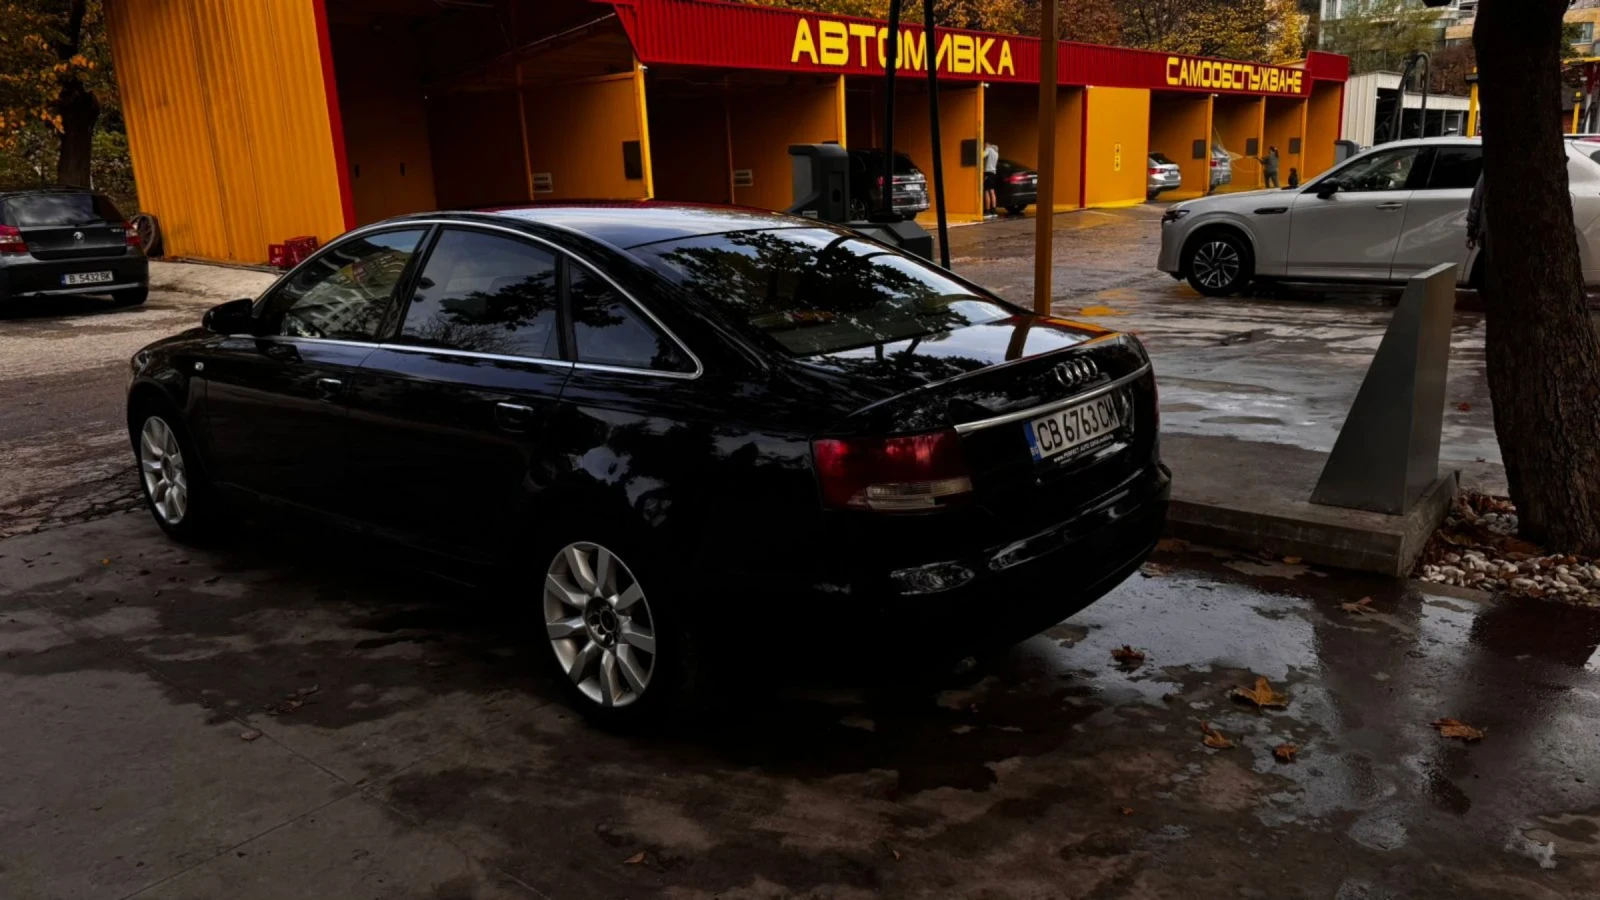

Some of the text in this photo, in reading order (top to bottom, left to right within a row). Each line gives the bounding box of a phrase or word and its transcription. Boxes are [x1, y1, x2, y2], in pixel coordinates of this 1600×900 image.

[791, 18, 1015, 76] АВТОМИВКА
[1037, 418, 1063, 451] CB
[1063, 405, 1099, 442] 6763
